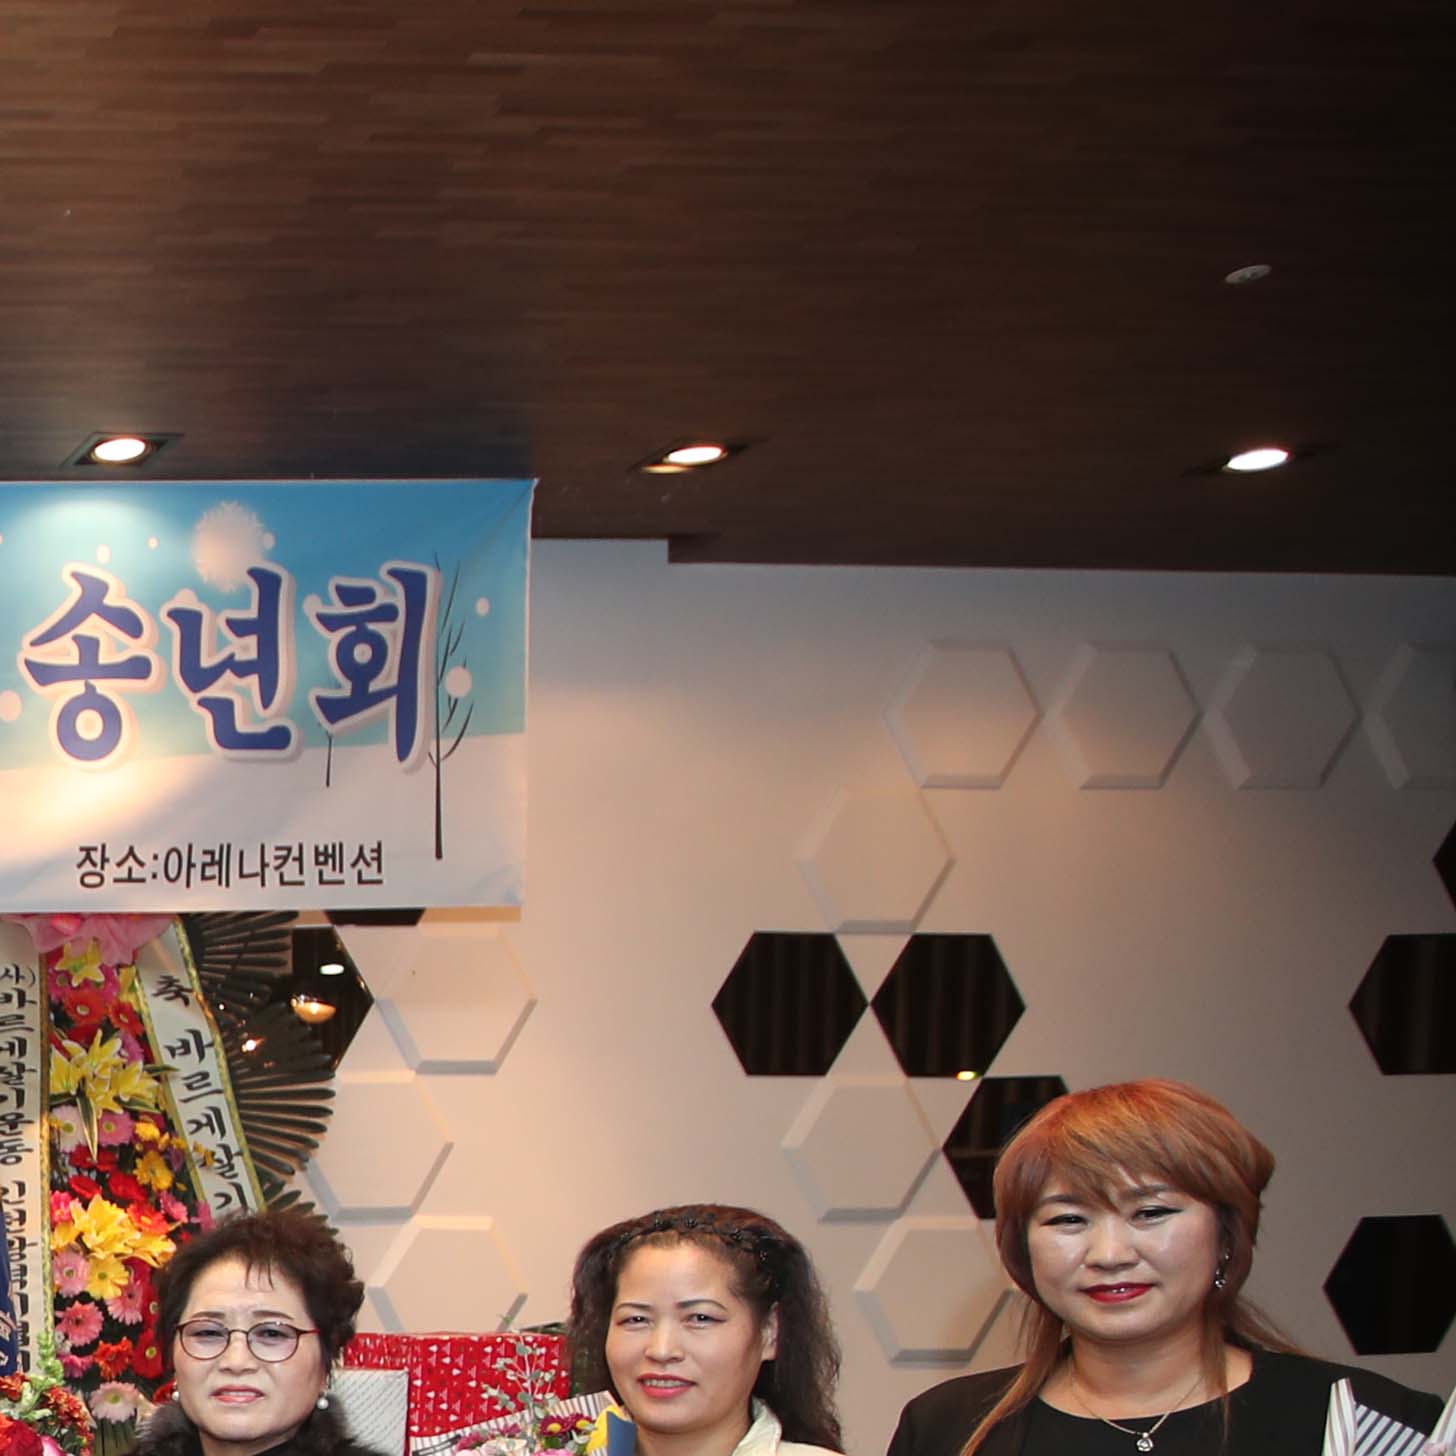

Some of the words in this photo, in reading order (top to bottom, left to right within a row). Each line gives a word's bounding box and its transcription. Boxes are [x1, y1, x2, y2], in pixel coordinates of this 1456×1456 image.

[20, 564, 432, 765] 송년회
[76, 840, 384, 889] 장소:아레나컨벤션
[151, 974, 192, 1006] 축
